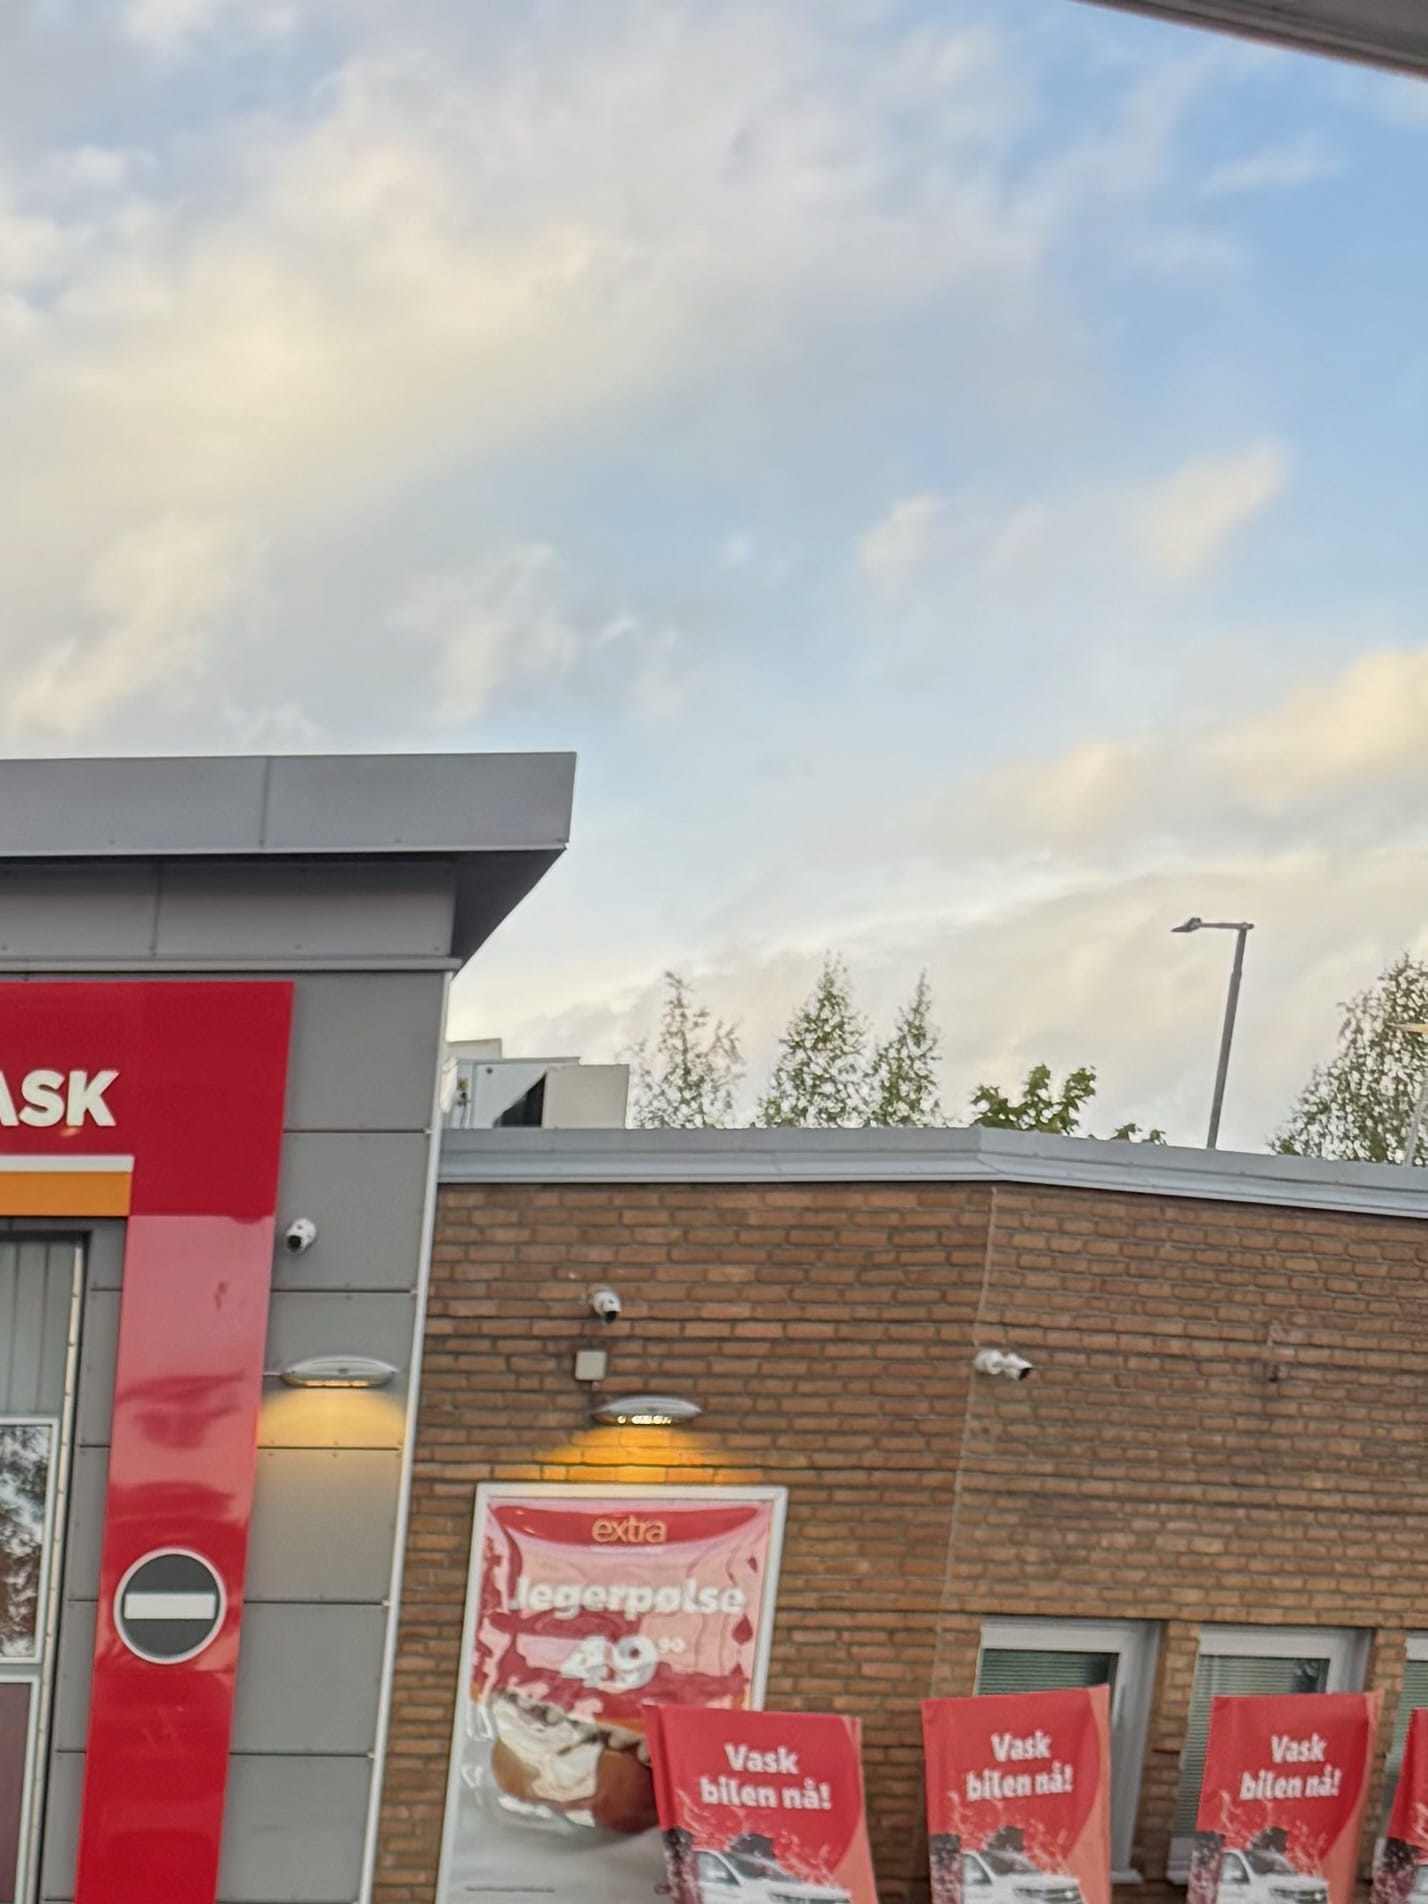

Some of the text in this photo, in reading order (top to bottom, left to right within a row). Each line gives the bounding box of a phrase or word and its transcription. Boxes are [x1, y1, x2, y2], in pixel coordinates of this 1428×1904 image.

[592, 1514, 667, 1544] extra
[560, 1635, 658, 1694] 49
[724, 1743, 799, 1775] Vask
[990, 1730, 1052, 1762] Vask
[1270, 1732, 1327, 1764] Vask
[699, 1776, 833, 1811] bilen nå!
[966, 1760, 1074, 1802] bilen nå!
[1239, 1763, 1342, 1801] bilen nå!
